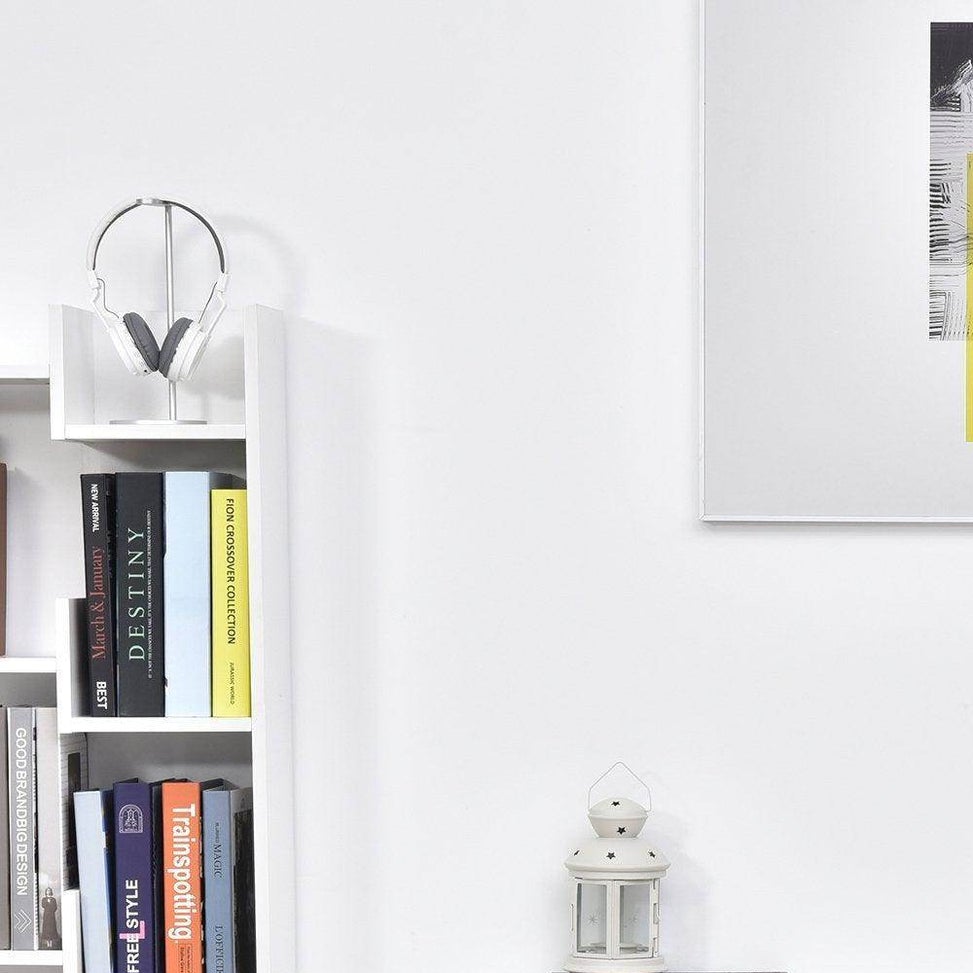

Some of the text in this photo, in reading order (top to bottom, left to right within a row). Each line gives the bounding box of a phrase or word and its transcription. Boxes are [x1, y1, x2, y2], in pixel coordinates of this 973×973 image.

[92, 501, 100, 532] ARRIVAL
[90, 546, 106, 660] March & January
[128, 528, 145, 660] DESTINY
[226, 498, 235, 645] FION CROSSOVER COLLECTION
[96, 681, 108, 709] BEST
[168, 804, 196, 941] Trainspotting
[213, 844, 221, 879] MAGIC
[125, 879, 139, 929] STYLE
